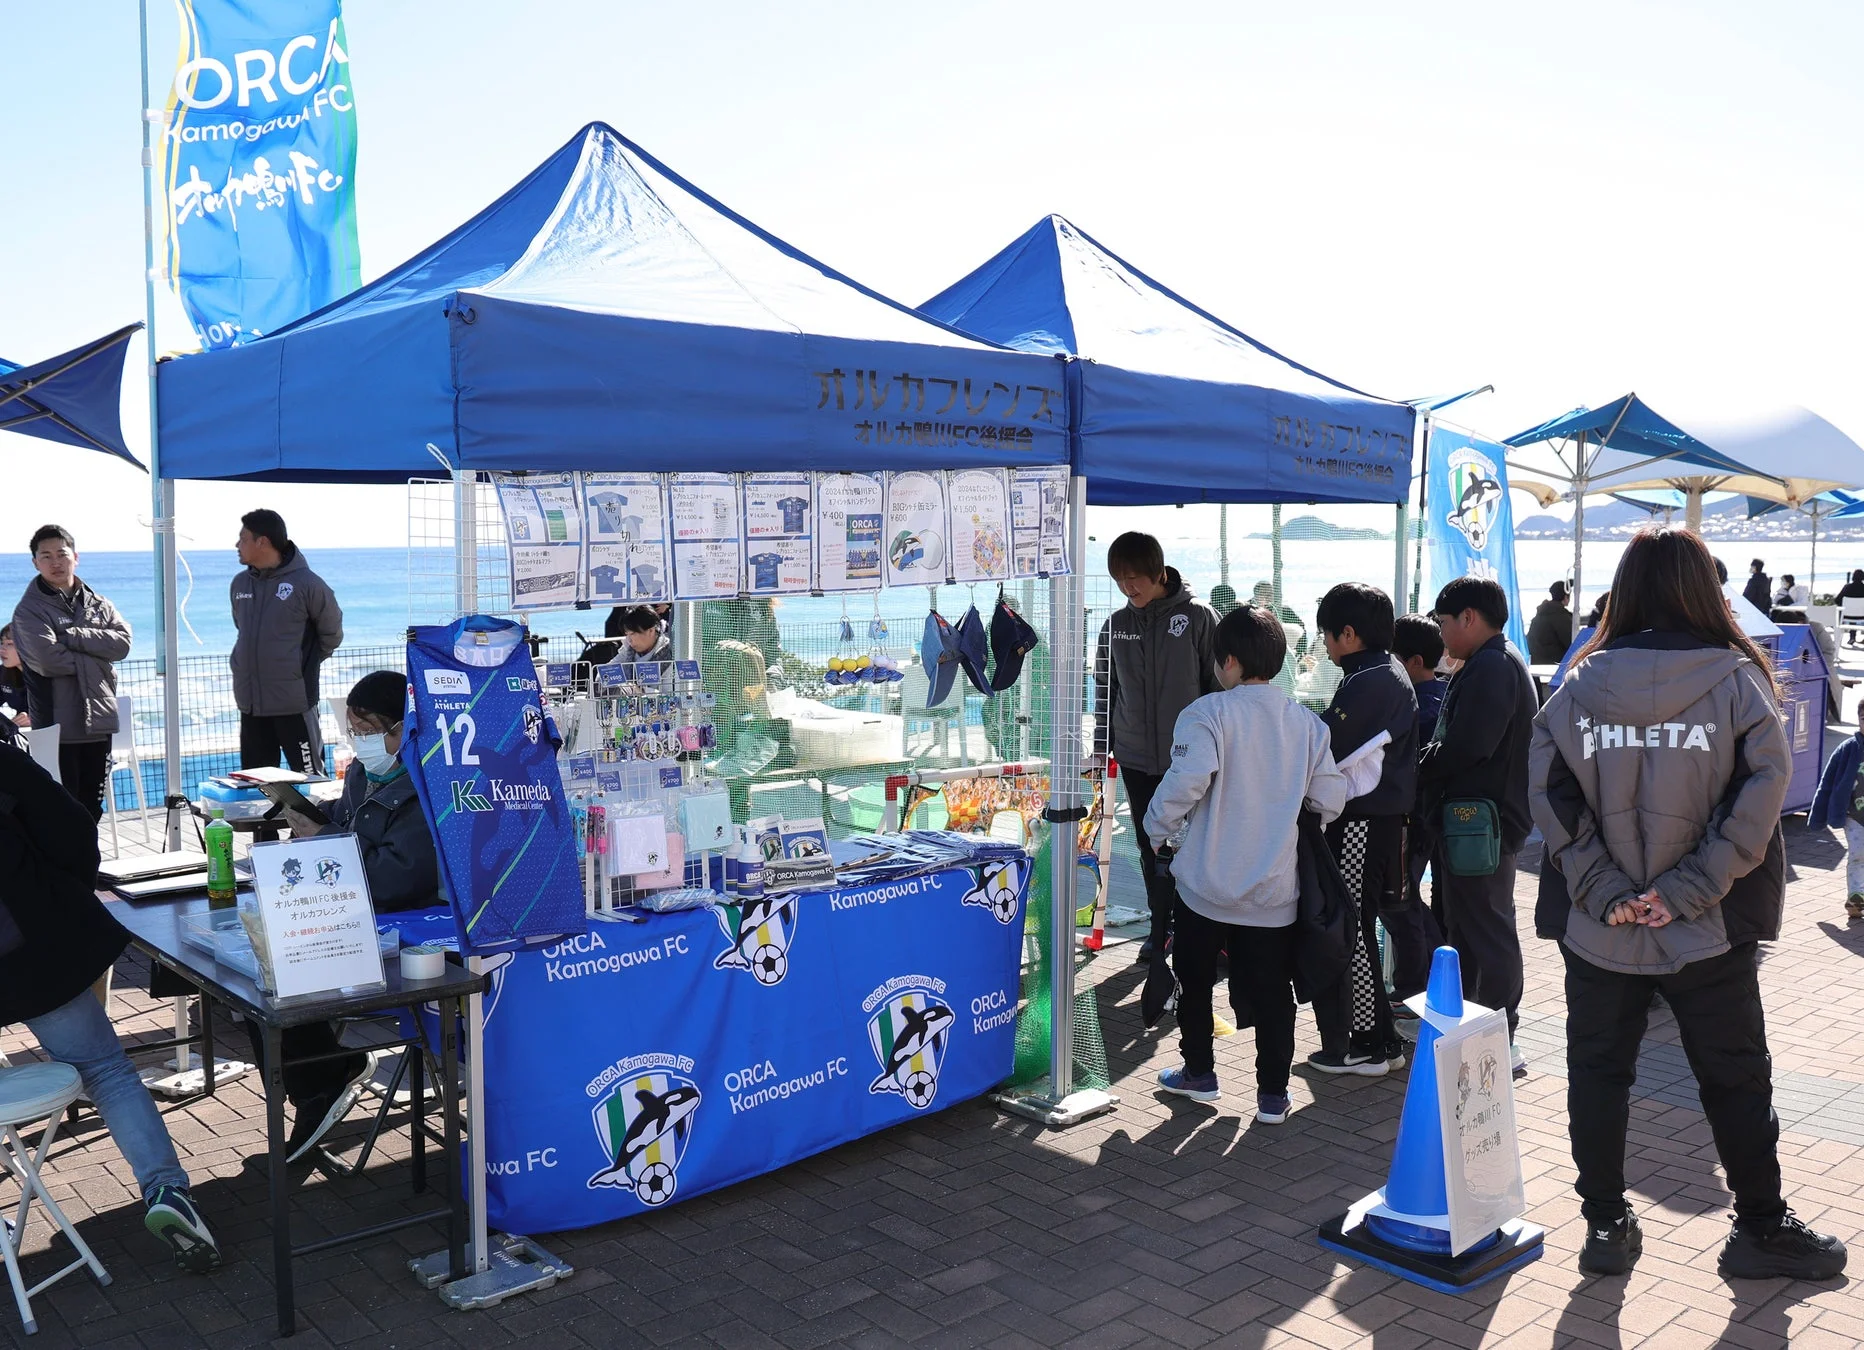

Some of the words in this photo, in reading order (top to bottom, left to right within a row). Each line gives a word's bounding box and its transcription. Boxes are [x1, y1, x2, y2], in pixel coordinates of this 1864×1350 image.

[174, 17, 350, 110] ORCA
[313, 84, 353, 118] FC
[812, 367, 1063, 423] オルカフレンズ
[854, 419, 1034, 451] オルカ鴨川FC後援会
[1273, 415, 1408, 462] オルカフレンズ
[822, 511, 844, 520] ¥400
[851, 519, 874, 529] ORCA
[953, 505, 977, 513] ¥1,500
[433, 676, 463, 685] SEDIA
[434, 702, 471, 710] ATHLETA
[436, 713, 481, 766] 12
[1583, 722, 1711, 760] ATHLETA
[489, 779, 551, 801] Kameda
[504, 801, 527, 810] Medical
[528, 801, 544, 810] Center
[1033, 792, 1043, 809] 5
[776, 871, 796, 880] ORCA
[795, 867, 825, 880] Kamogawa
[825, 866, 834, 875] FC
[829, 882, 919, 912] Kamogawa
[922, 874, 943, 892] FC
[291, 905, 347, 921] オルカフレンズ
[545, 946, 661, 983] Kamogawa
[664, 934, 690, 956] FC
[862, 985, 888, 1012] ORCA
[886, 975, 932, 992] Kamogawa
[931, 977, 946, 994] FC
[971, 989, 1007, 1015] ORCA
[586, 1066, 618, 1098] ORCA
[617, 1053, 676, 1071] Kamogawa
[677, 1055, 695, 1073] FC
[724, 1060, 778, 1092] ORCA
[729, 1070, 825, 1114] Kamogawa
[827, 1057, 849, 1079] FC
[526, 1147, 558, 1172] FC
[1465, 1131, 1501, 1164] グッズ売り場
